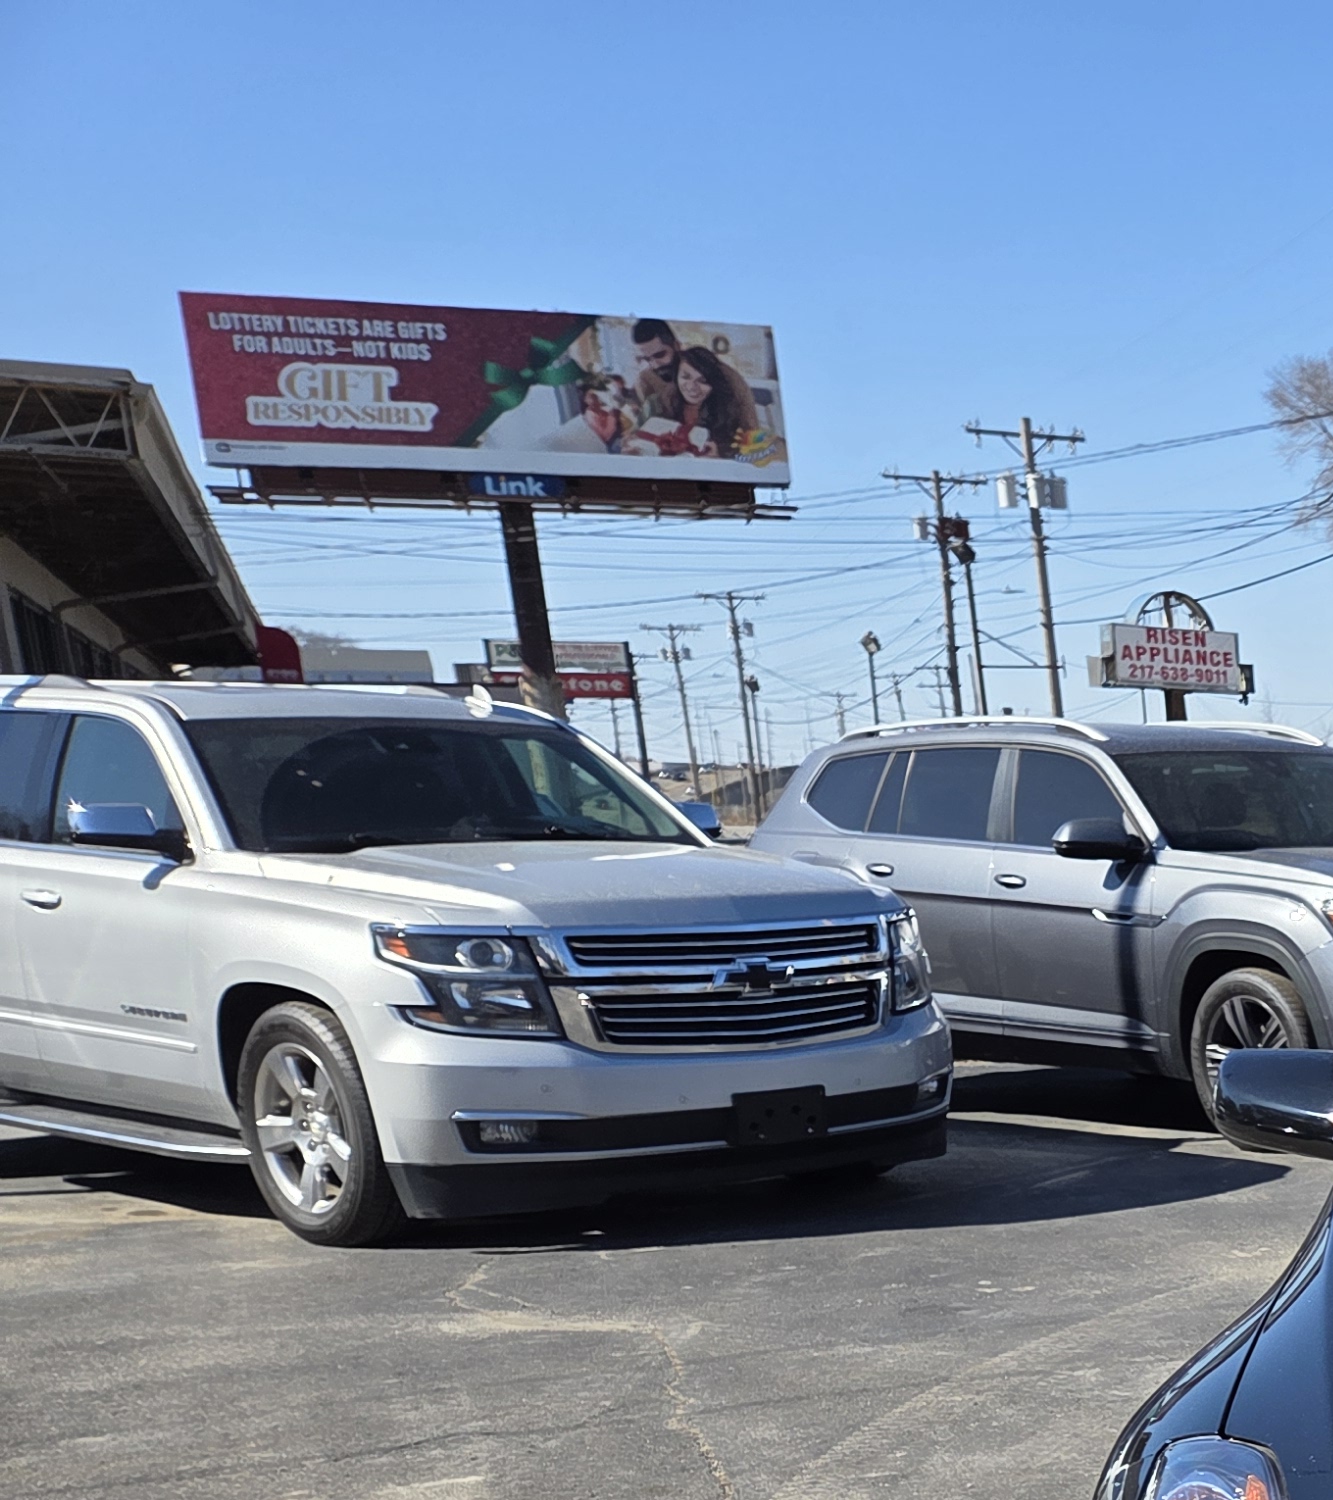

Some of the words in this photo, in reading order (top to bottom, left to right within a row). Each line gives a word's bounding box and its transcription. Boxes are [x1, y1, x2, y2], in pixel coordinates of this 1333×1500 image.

[207, 311, 285, 333] LOTTERY
[286, 315, 360, 337] TICKETS
[362, 319, 395, 340] ARE
[397, 321, 447, 341] GIFTS
[232, 334, 268, 353] FOR
[390, 342, 432, 361] KIDS
[285, 367, 393, 402] GIFT
[252, 401, 431, 426] RESPONSIBLY
[483, 475, 547, 497] Link
[1146, 628, 1207, 647] RISEN
[1121, 645, 1233, 667] APPLIANCE
